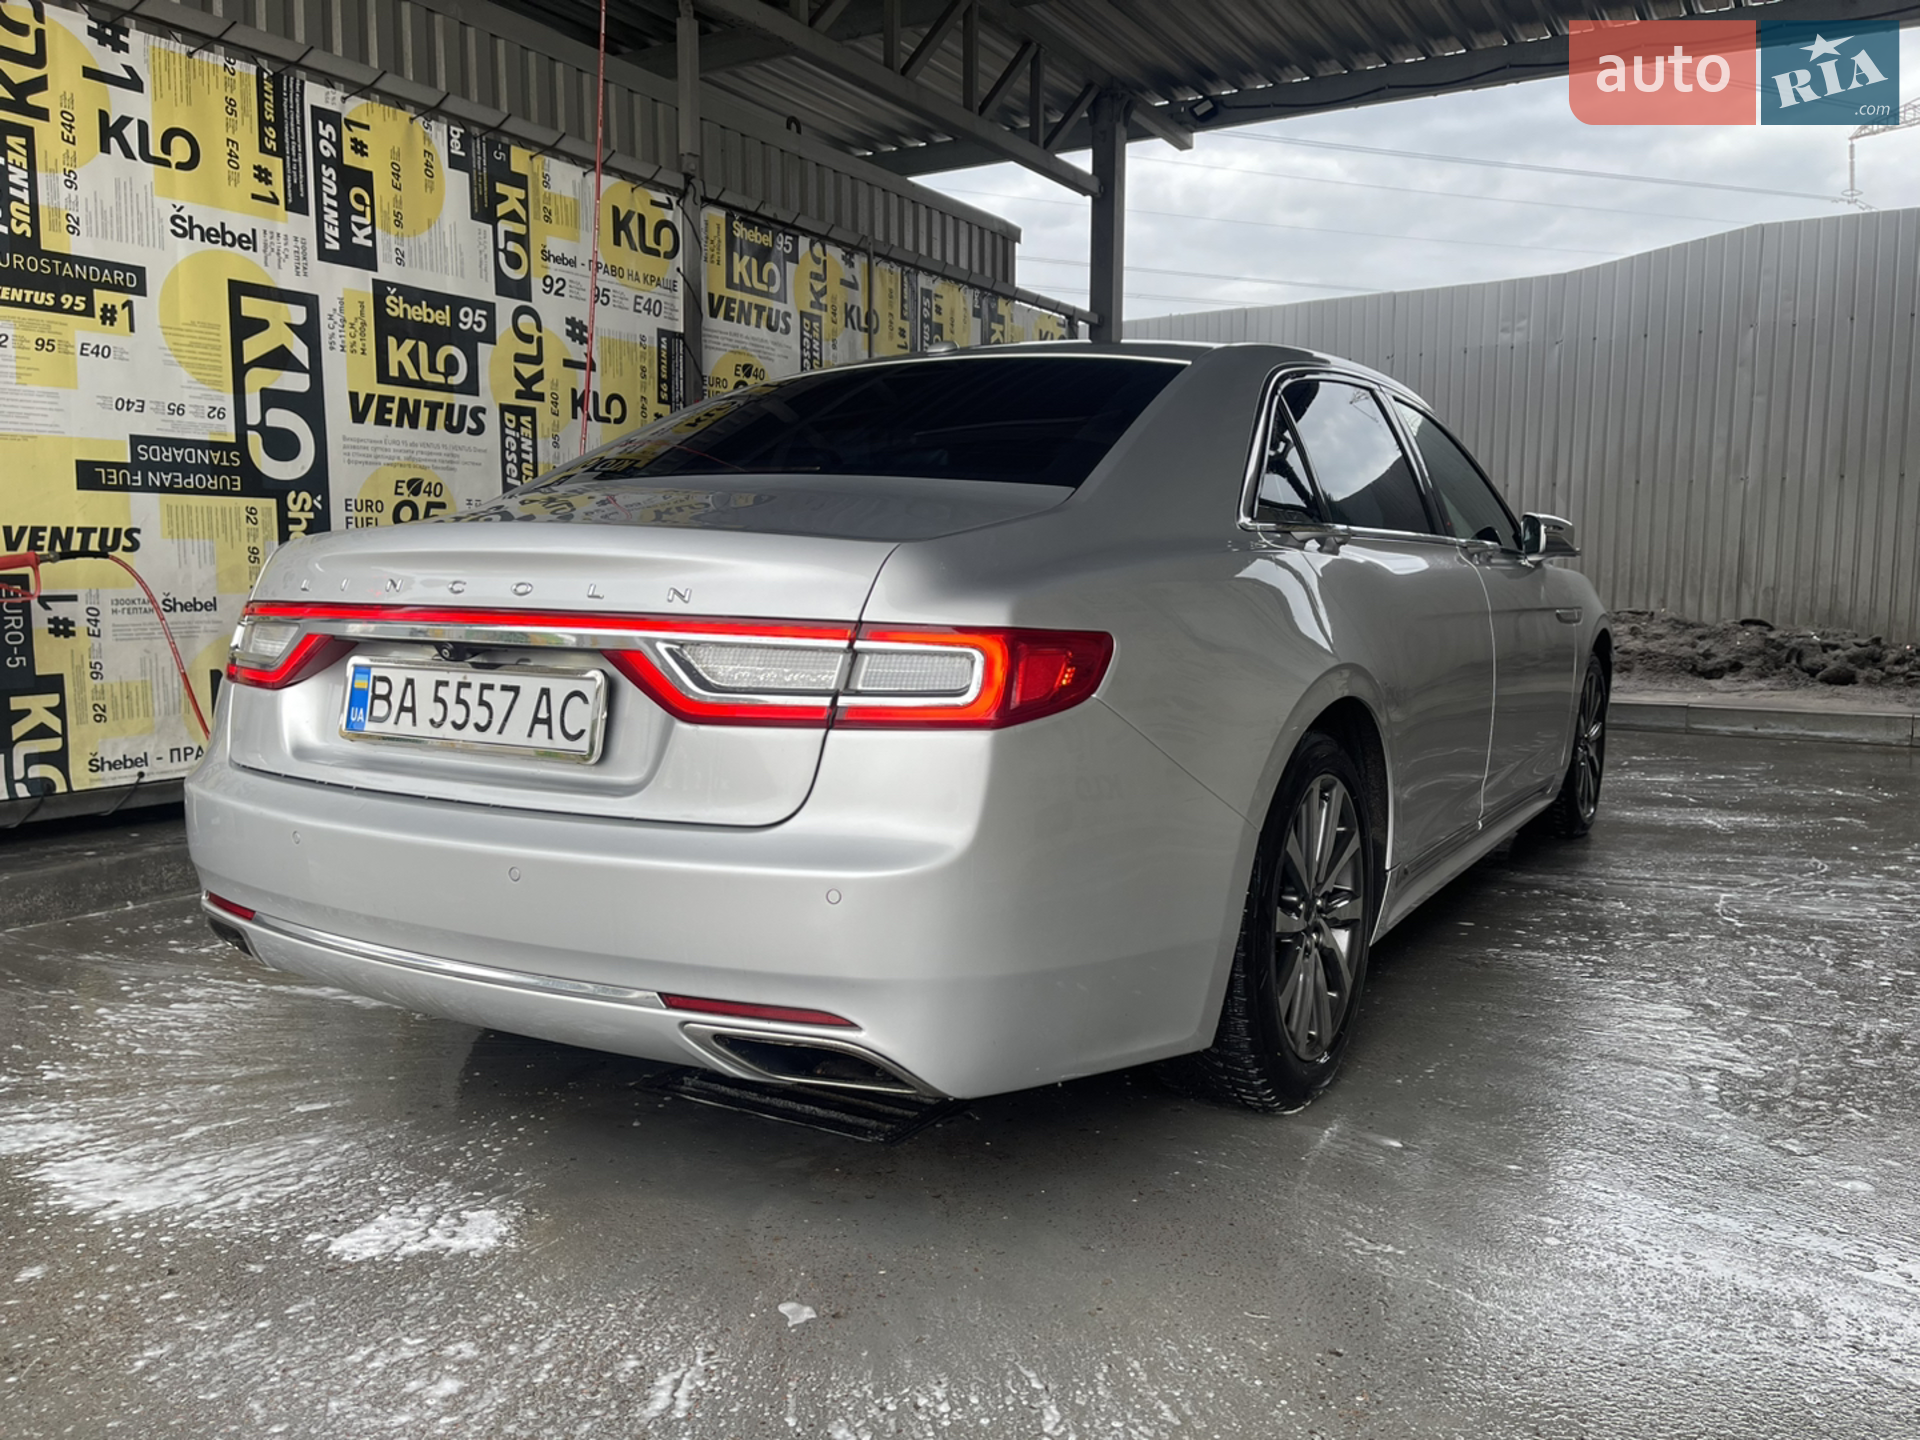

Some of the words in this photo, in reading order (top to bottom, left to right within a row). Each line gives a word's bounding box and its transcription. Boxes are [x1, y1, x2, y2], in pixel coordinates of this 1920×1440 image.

[81, 17, 146, 94] #1
[224, 95, 239, 120] 95
[263, 71, 274, 121] NTUS
[61, 109, 76, 146] E40
[98, 108, 201, 171] KLO
[264, 127, 277, 152] 95
[318, 120, 337, 158] 95
[343, 117, 371, 158] #1
[226, 137, 241, 170] E40
[423, 149, 435, 179] E40
[7, 137, 32, 237] VENTUS
[62, 167, 78, 191] 95
[251, 163, 281, 206] #1
[390, 160, 402, 192] E40
[541, 171, 552, 190] 95
[321, 164, 341, 250] VENTUS
[349, 186, 373, 247] KLO
[393, 209, 404, 229] 95
[542, 206, 553, 224] 92
[66, 212, 80, 236] 92
[169, 204, 258, 252] Šhebel
[495, 182, 529, 281] KLO
[612, 204, 681, 260] KLO
[732, 214, 773, 248] Šhebel
[775, 232, 793, 254] 95
[540, 243, 577, 269] Šhebel
[627, 269, 640, 283] НА
[642, 272, 678, 293] КРАЩЕ
[733, 251, 781, 294] KLO
[809, 238, 828, 312] KLO
[0, 286, 56, 306] ENTUS
[60, 293, 87, 311] 95
[385, 286, 451, 327] Šhebel
[458, 306, 488, 333] 95
[541, 275, 566, 298] 92
[594, 286, 611, 307] 95
[632, 295, 662, 317] E40
[922, 297, 931, 319] 95
[99, 299, 135, 333] #1
[707, 291, 792, 335] VENTUS
[844, 302, 880, 335] KLO
[34, 337, 56, 353] 95
[79, 342, 112, 359] E40
[511, 304, 545, 402] KLO
[563, 316, 597, 372] #1
[639, 334, 647, 350] 92
[657, 337, 668, 379] VENTUS
[387, 335, 468, 386] KLO
[639, 365, 647, 380] 95
[239, 294, 316, 482] KLO
[702, 374, 728, 389] EURO
[114, 397, 145, 414] E40
[167, 403, 186, 417] 95
[207, 406, 226, 420] 92
[348, 390, 487, 436] VENTUS
[550, 392, 559, 417] E40
[571, 388, 627, 425] KLO
[639, 396, 647, 419] E40
[137, 444, 241, 467] STANDARDS
[503, 412, 521, 487] Diesel
[552, 433, 560, 449] 95
[94, 468, 142, 487] FUEL
[148, 471, 241, 491] EUROPEAN
[245, 506, 258, 526] 92
[286, 490, 322, 541] Šh
[344, 499, 384, 513] EURO
[3, 526, 141, 553] VENTUS
[247, 546, 261, 565] 95
[162, 592, 217, 613] Šhebel
[300, 577, 692, 604] LINCOLN
[37, 594, 79, 639] #1
[87, 606, 101, 638] E40
[90, 661, 103, 681] 95
[94, 703, 107, 724] 92
[350, 706, 364, 723] UA
[368, 675, 417, 728] BA
[428, 680, 521, 735] 5557
[527, 686, 589, 742] AC
[9, 693, 69, 799] KLO
[88, 752, 149, 773] Šhebel
